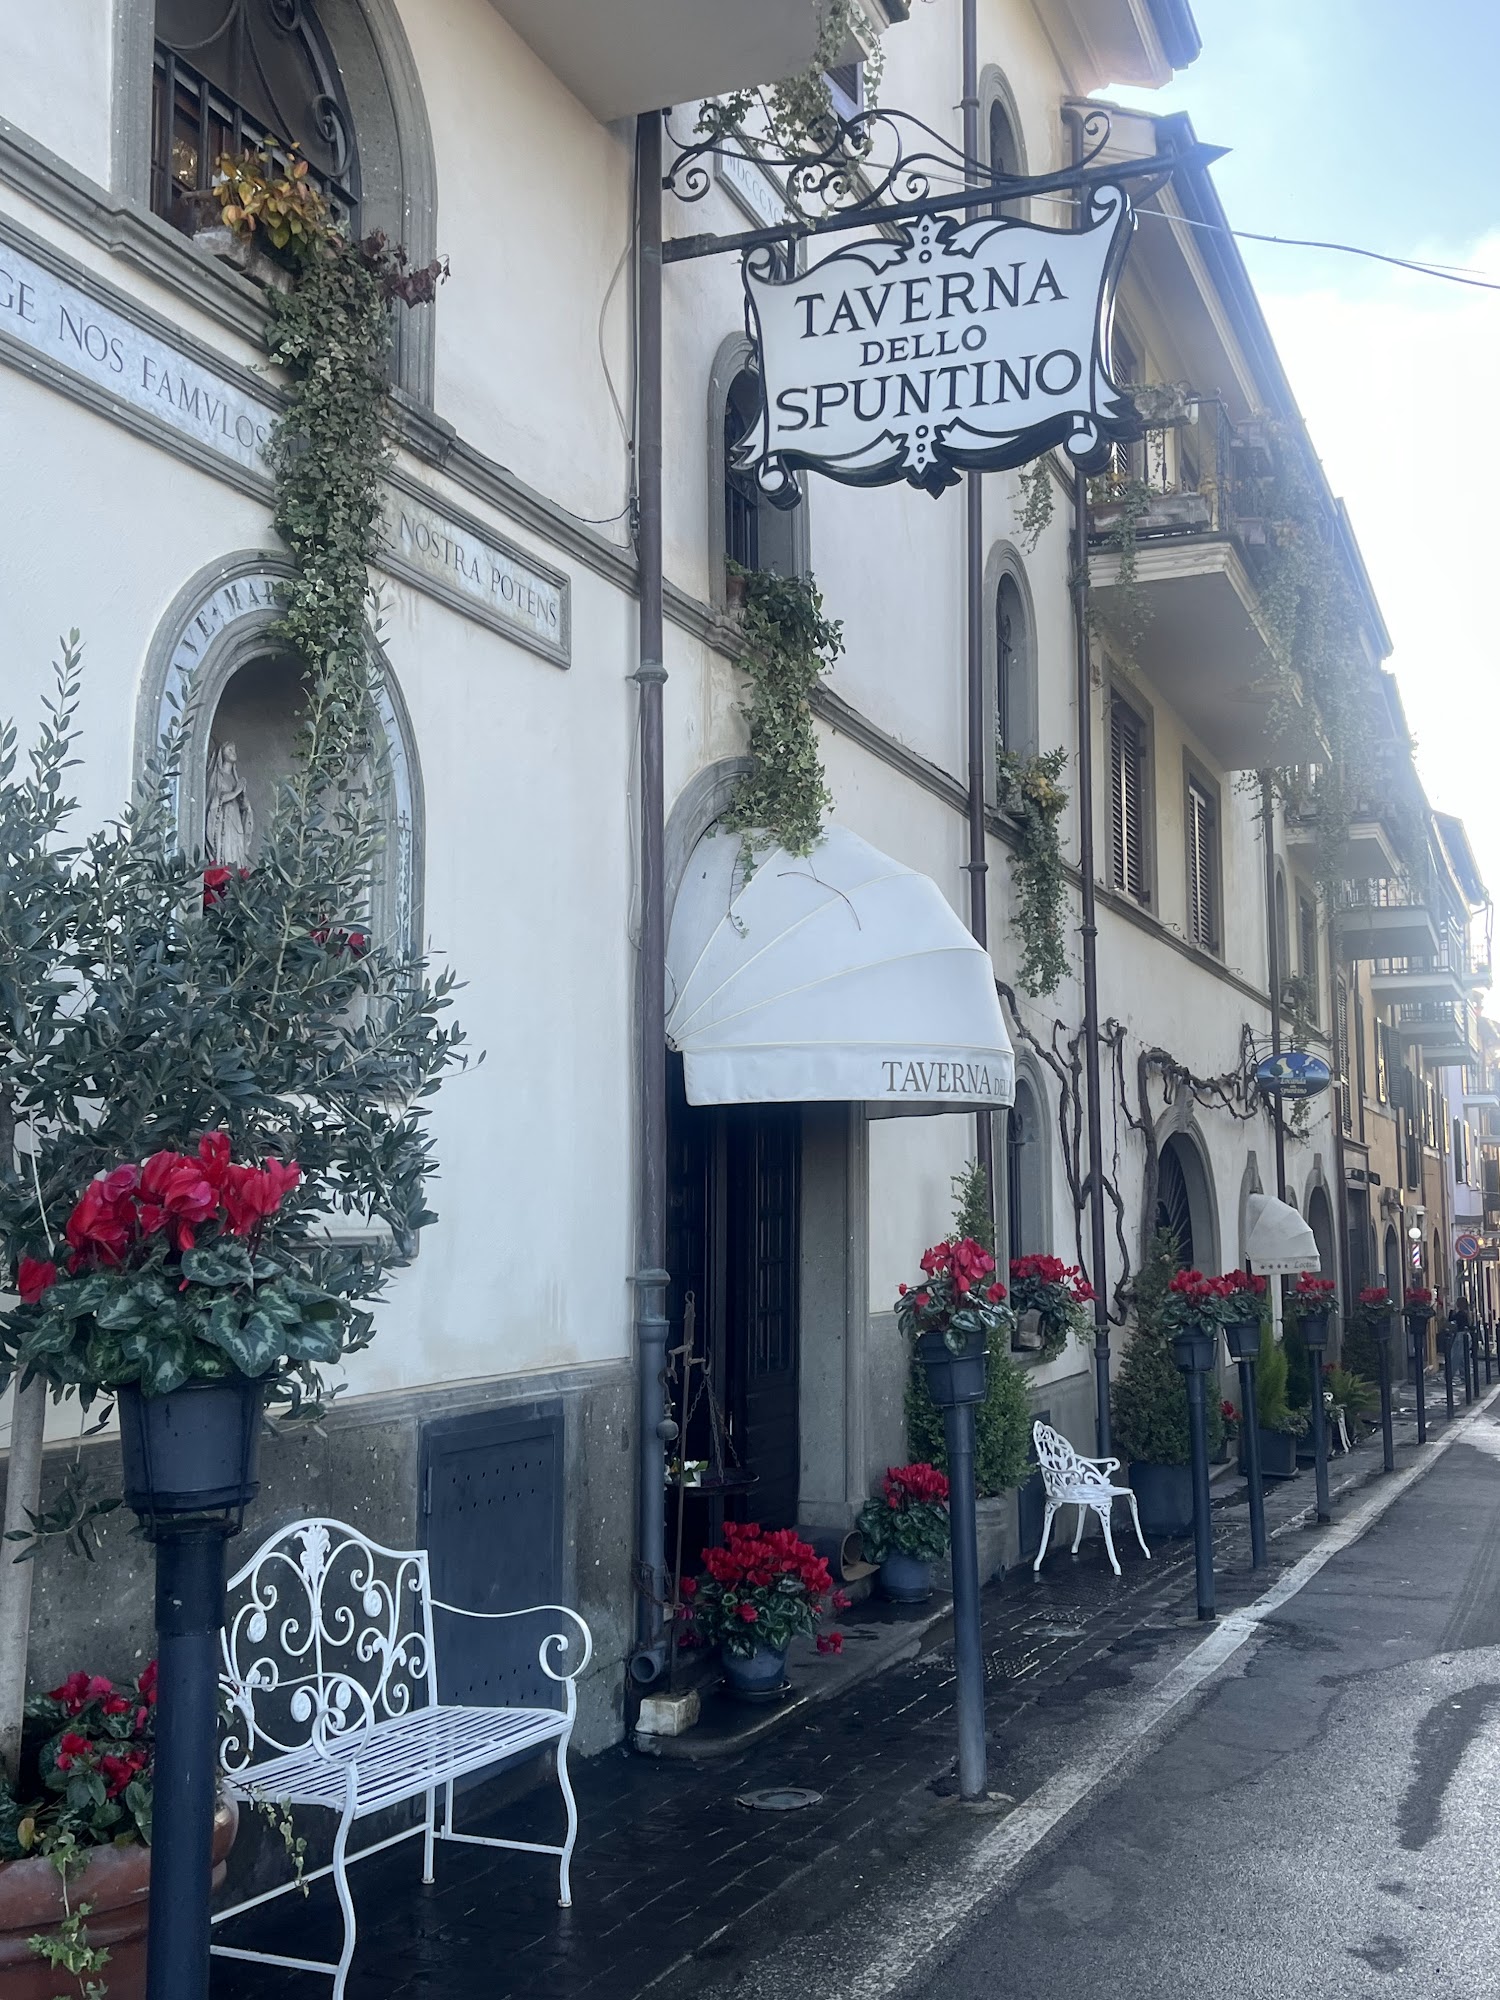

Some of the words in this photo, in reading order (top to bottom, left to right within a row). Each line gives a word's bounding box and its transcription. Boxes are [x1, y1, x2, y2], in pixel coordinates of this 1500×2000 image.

[794, 258, 1070, 339] TAVERNA
[858, 324, 988, 368] DELLO
[775, 349, 1083, 432] SPUNTINO
[57, 304, 124, 374] NOS
[140, 354, 267, 452] FAMVLOS
[399, 510, 482, 585] NOSTRA
[490, 566, 558, 628] POTENS
[881, 1061, 992, 1095] TAVERNA
